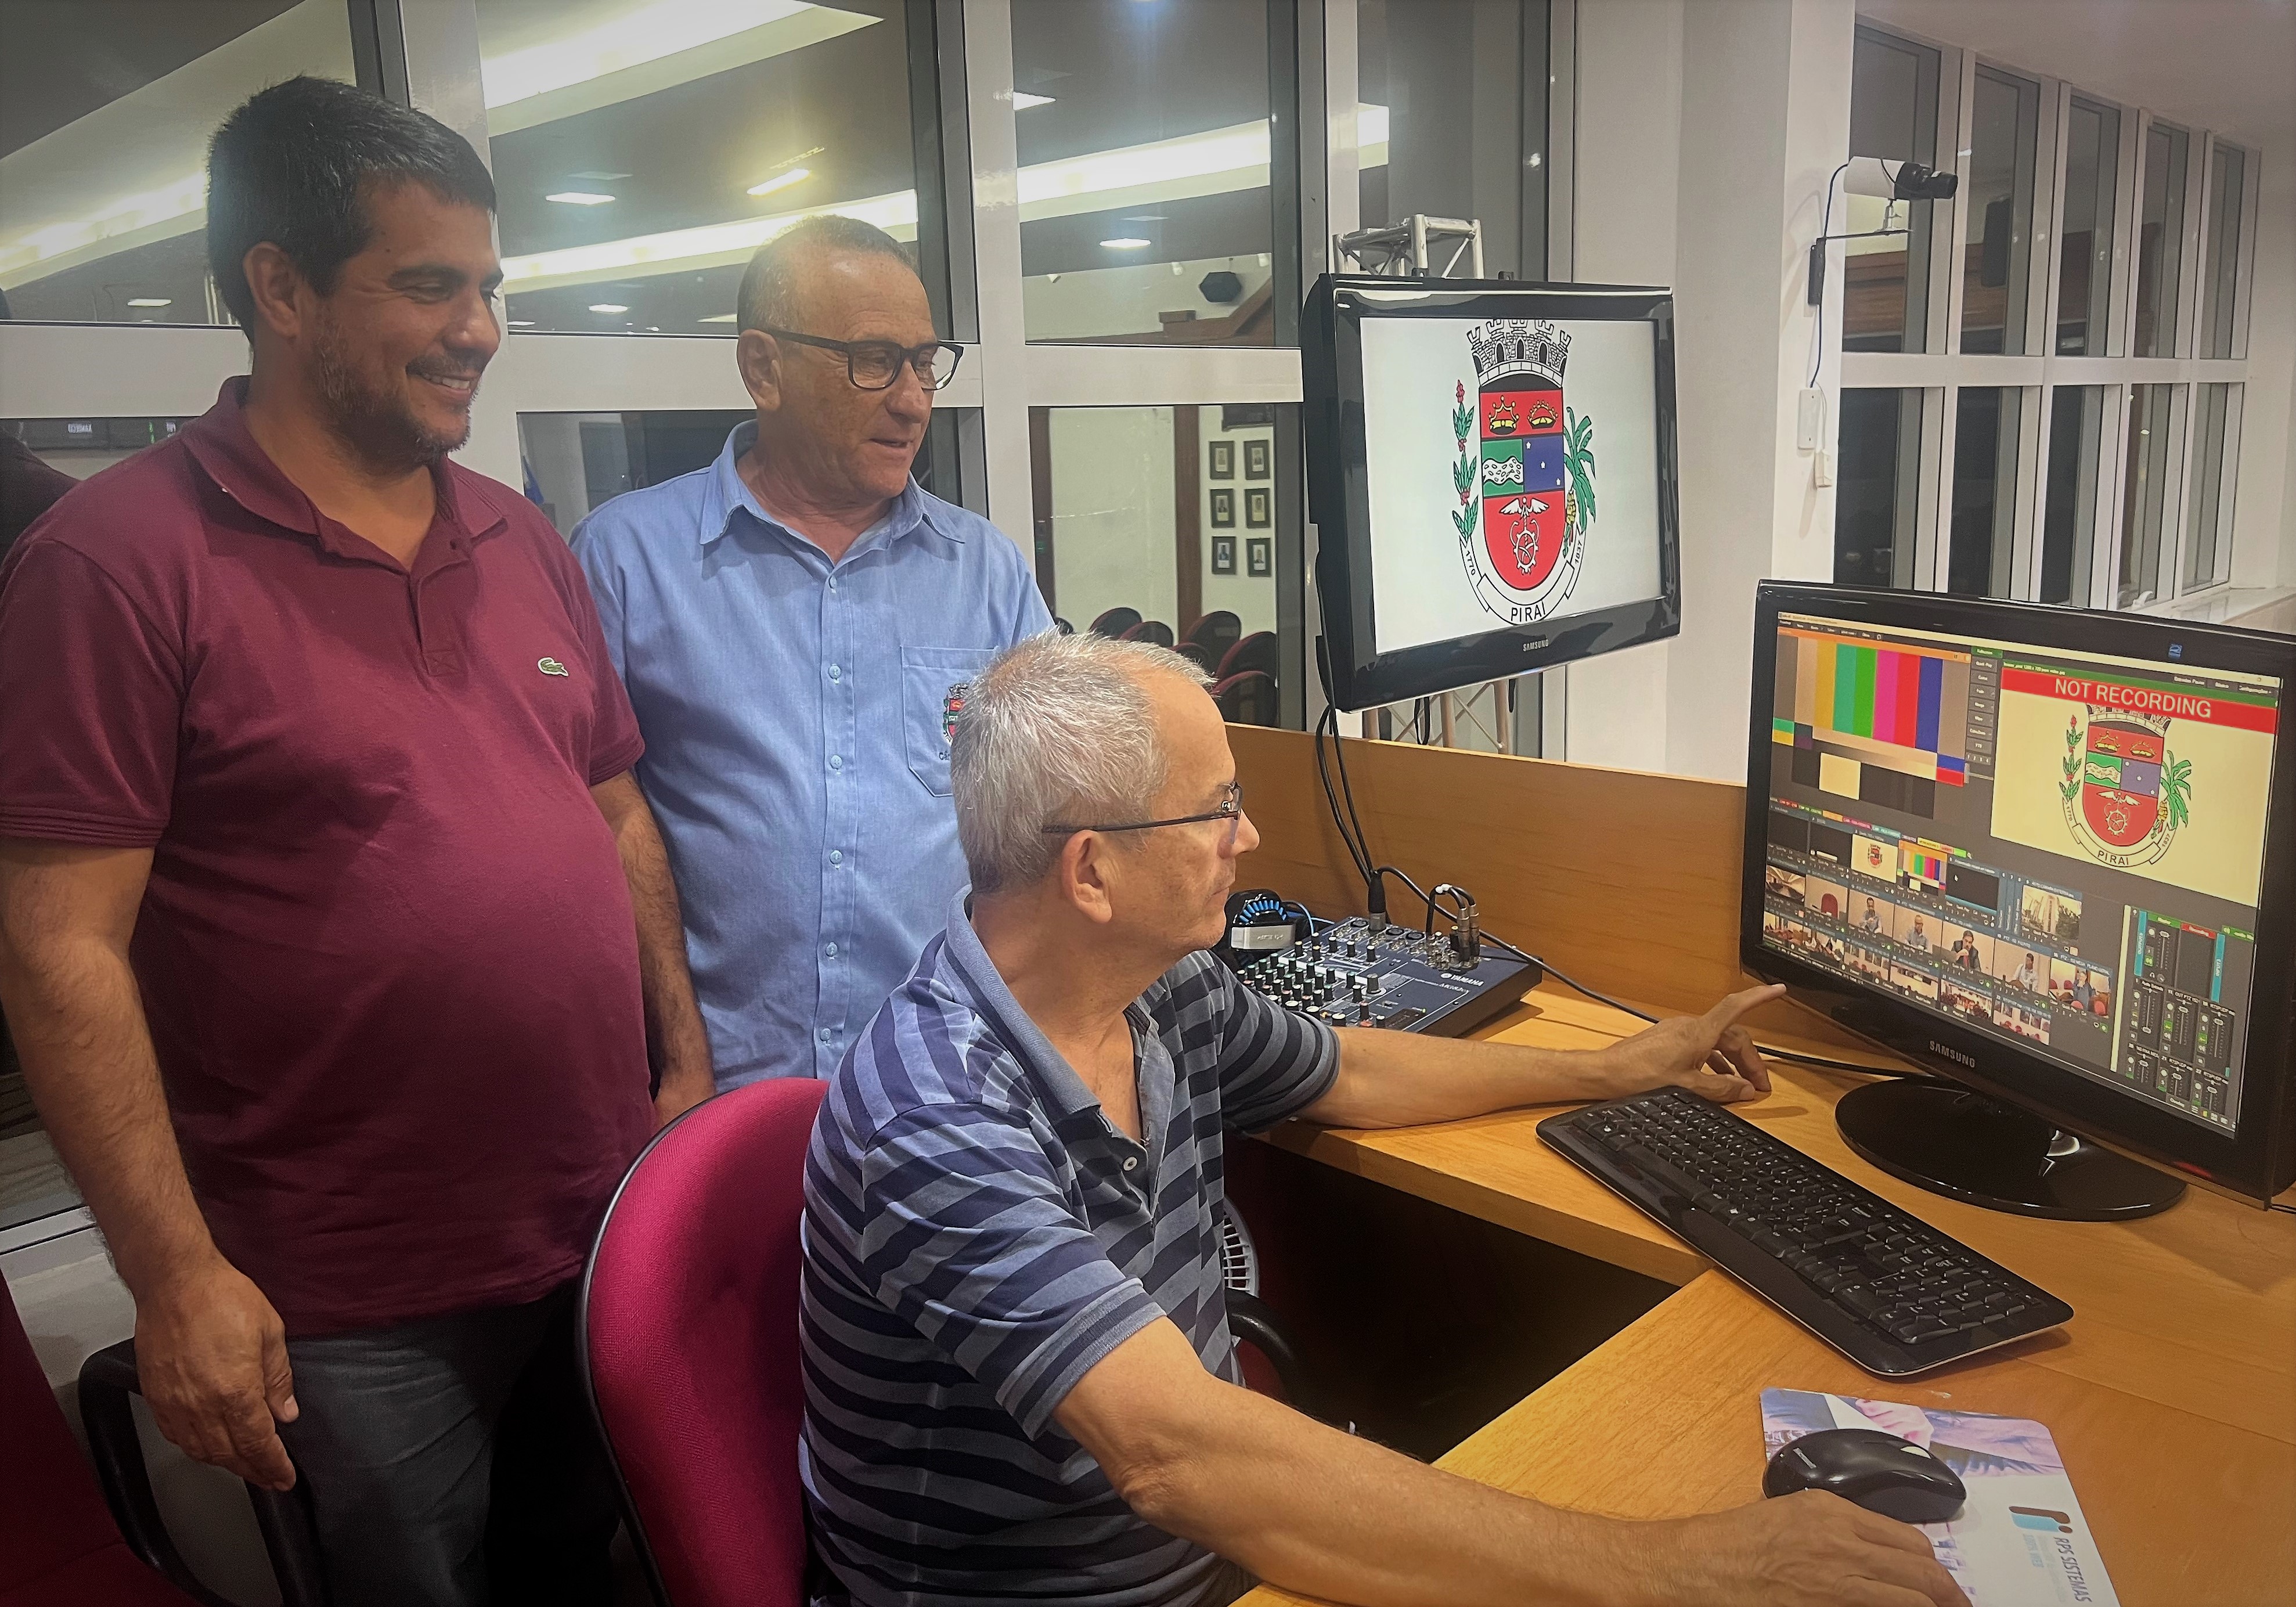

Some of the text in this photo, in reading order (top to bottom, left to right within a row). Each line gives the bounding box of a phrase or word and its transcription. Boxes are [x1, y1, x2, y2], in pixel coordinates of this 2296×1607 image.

[1465, 550, 1476, 575] 1770
[1574, 542, 1583, 564] 1837
[1523, 639, 1549, 651] SAMSUNG
[2055, 678, 2211, 718] NOT RECORDING
[2161, 833, 2171, 847] 1837
[2097, 850, 2129, 865] PIRAI
[1451, 975, 1484, 986] YAMAHA
[1930, 1040, 1975, 1068] SAMSUNG
[2053, 1537, 2092, 1602] RPS SISTEMAS
